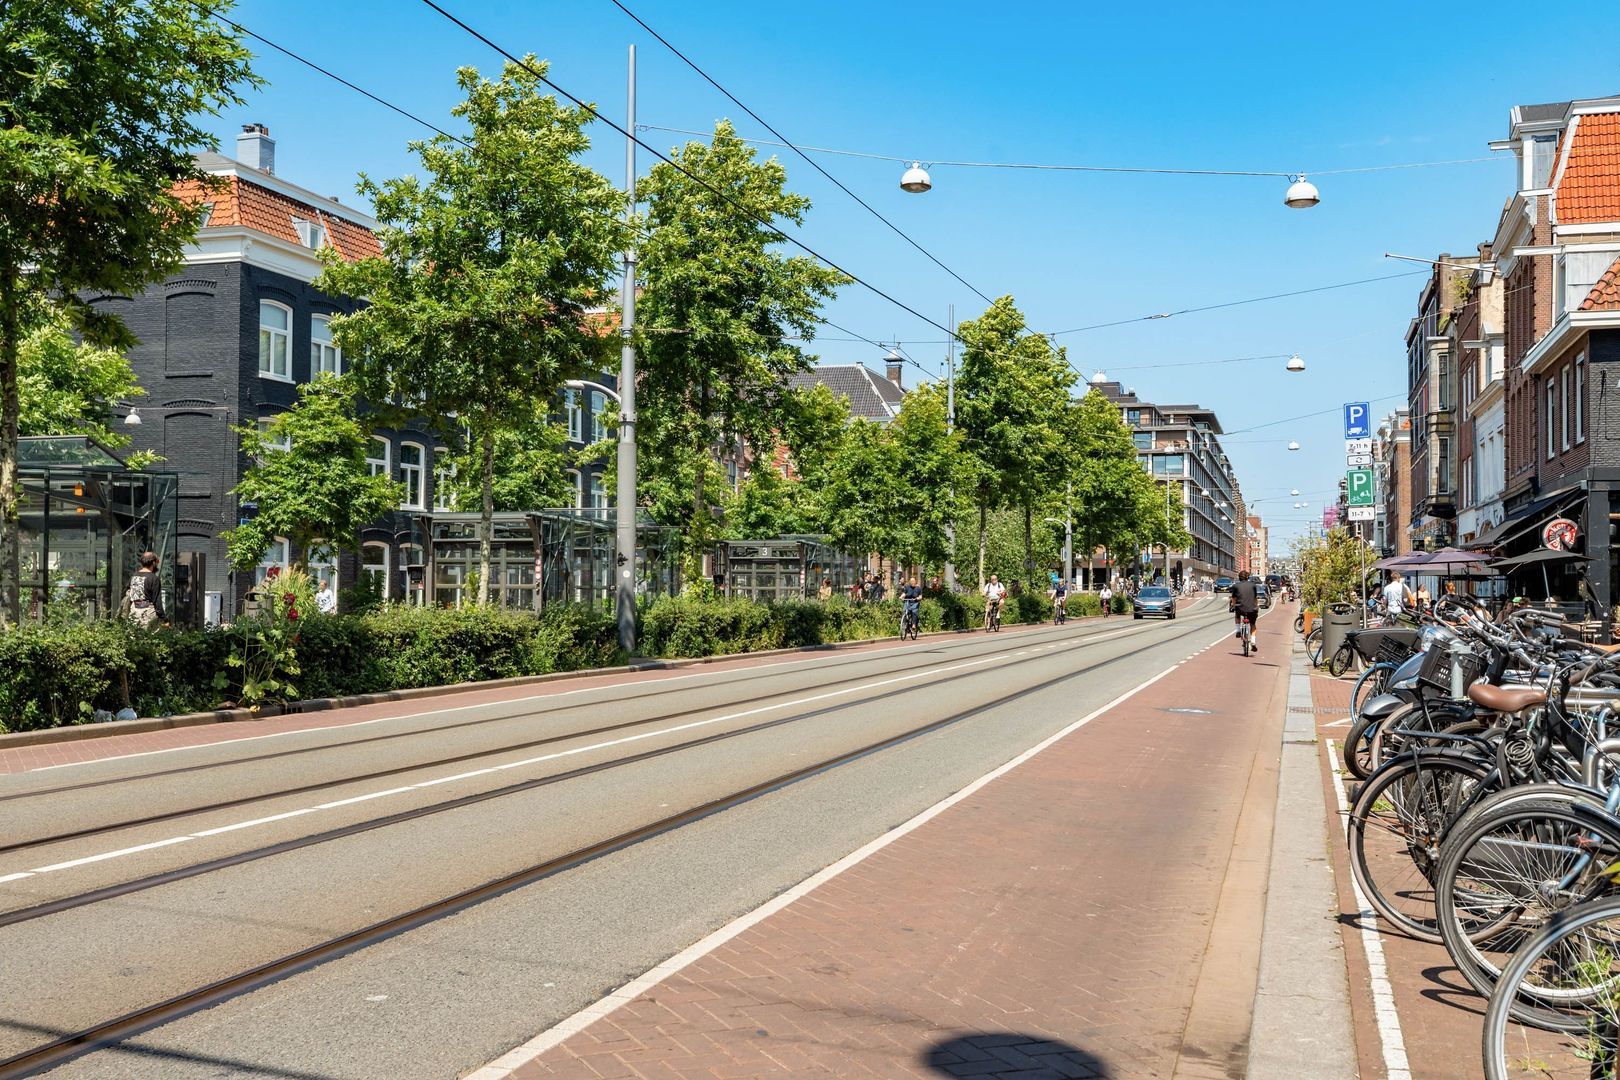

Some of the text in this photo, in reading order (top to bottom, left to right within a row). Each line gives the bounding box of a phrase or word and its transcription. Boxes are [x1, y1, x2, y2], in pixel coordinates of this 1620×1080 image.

[1350, 406, 1363, 424] P
[1353, 473, 1367, 491] P
[762, 547, 768, 556] 3
